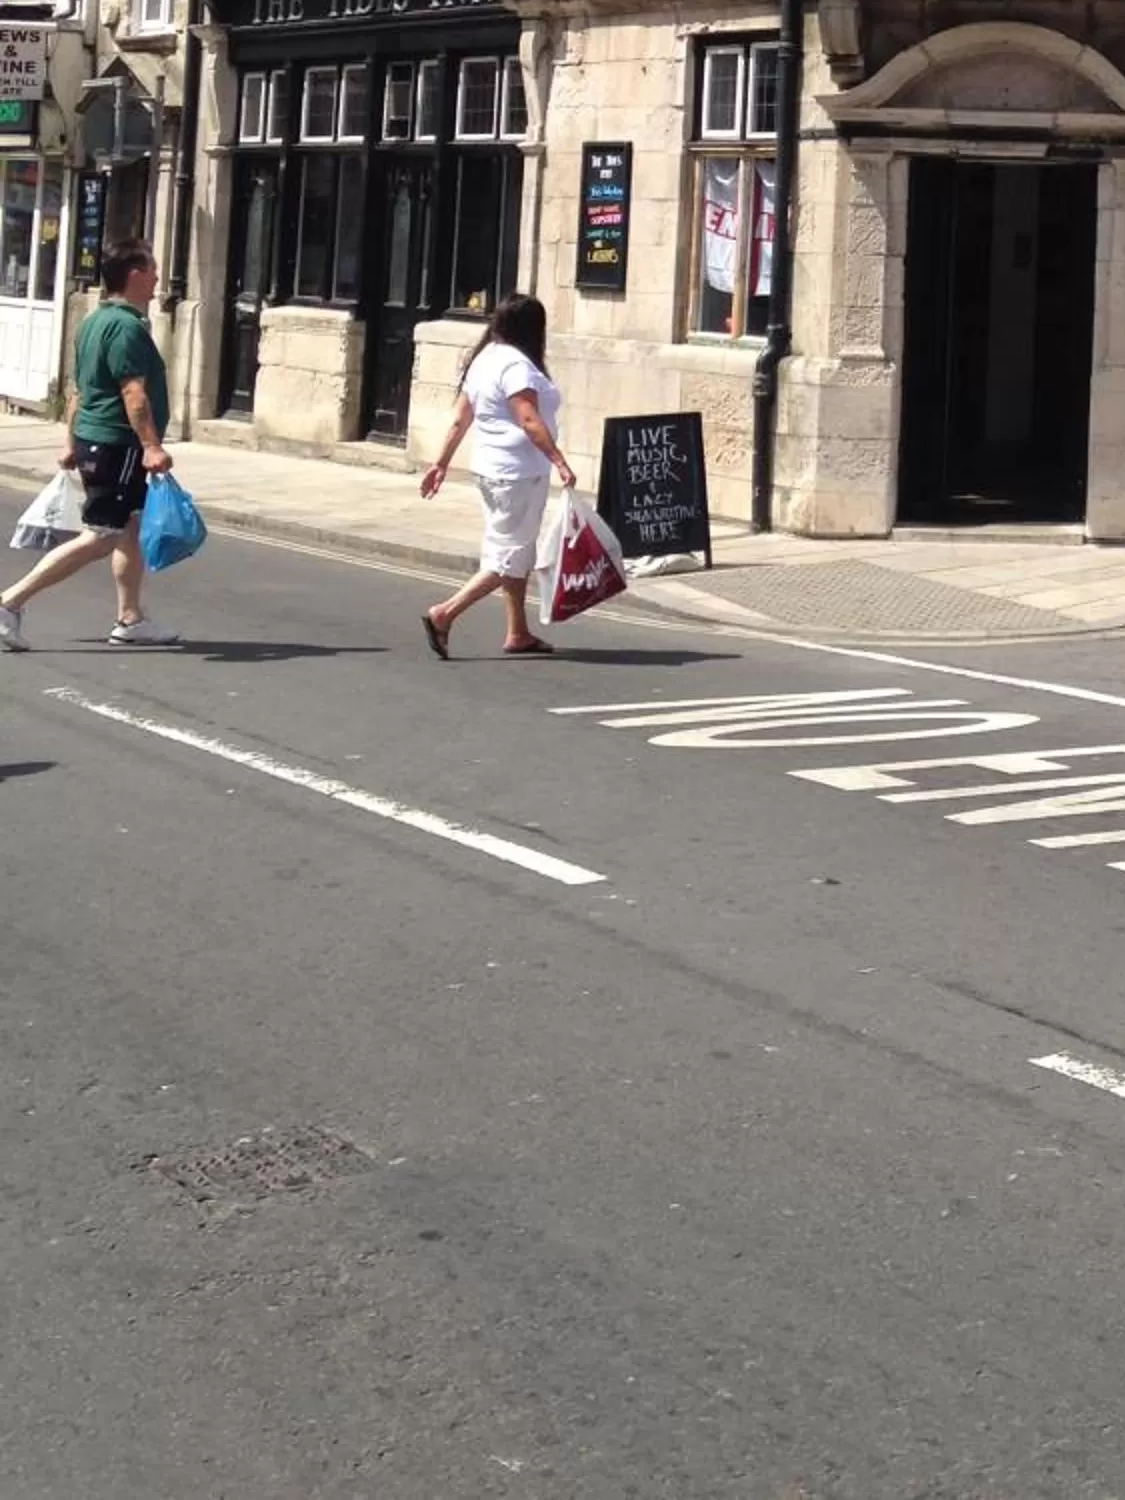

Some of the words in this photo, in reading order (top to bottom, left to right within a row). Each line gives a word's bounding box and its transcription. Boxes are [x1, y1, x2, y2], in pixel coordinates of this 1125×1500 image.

[0, 30, 40, 42] EWS
[4, 44, 17, 57] &
[0, 61, 37, 73] INE
[628, 424, 676, 448] LIVE
[627, 461, 681, 484] BEER
[640, 521, 681, 542] HERE
[548, 688, 1040, 748] NO
